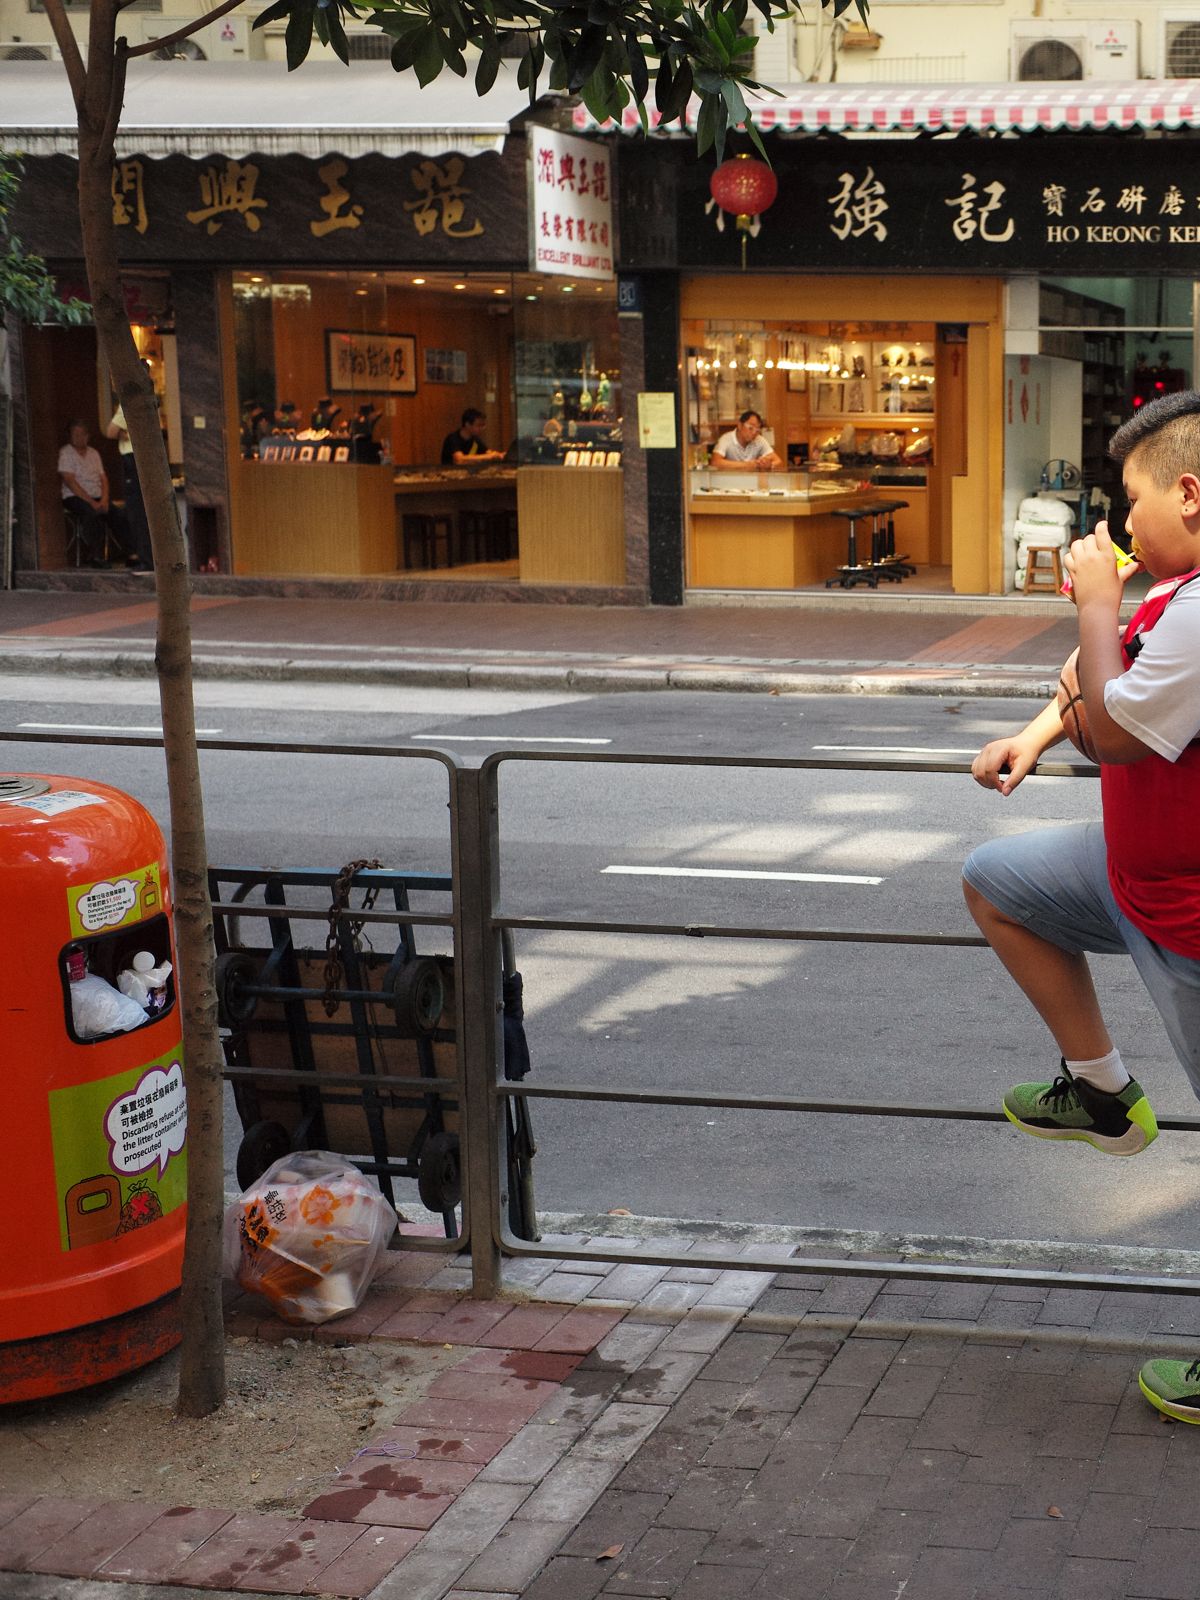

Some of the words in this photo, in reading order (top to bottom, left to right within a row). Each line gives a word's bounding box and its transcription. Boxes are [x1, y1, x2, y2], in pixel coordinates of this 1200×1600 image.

[705, 166, 1015, 242] 強記
[1047, 226, 1080, 244] HO
[1087, 226, 1161, 244] KEONG
[538, 248, 570, 264] EXCELLENT
[122, 1120, 158, 1140] Discarding
[159, 1110, 174, 1124] refuse
[122, 1140, 137, 1151] the
[138, 1133, 154, 1146] litter
[155, 1119, 178, 1138] container
[124, 1141, 162, 1165] prosecuted
